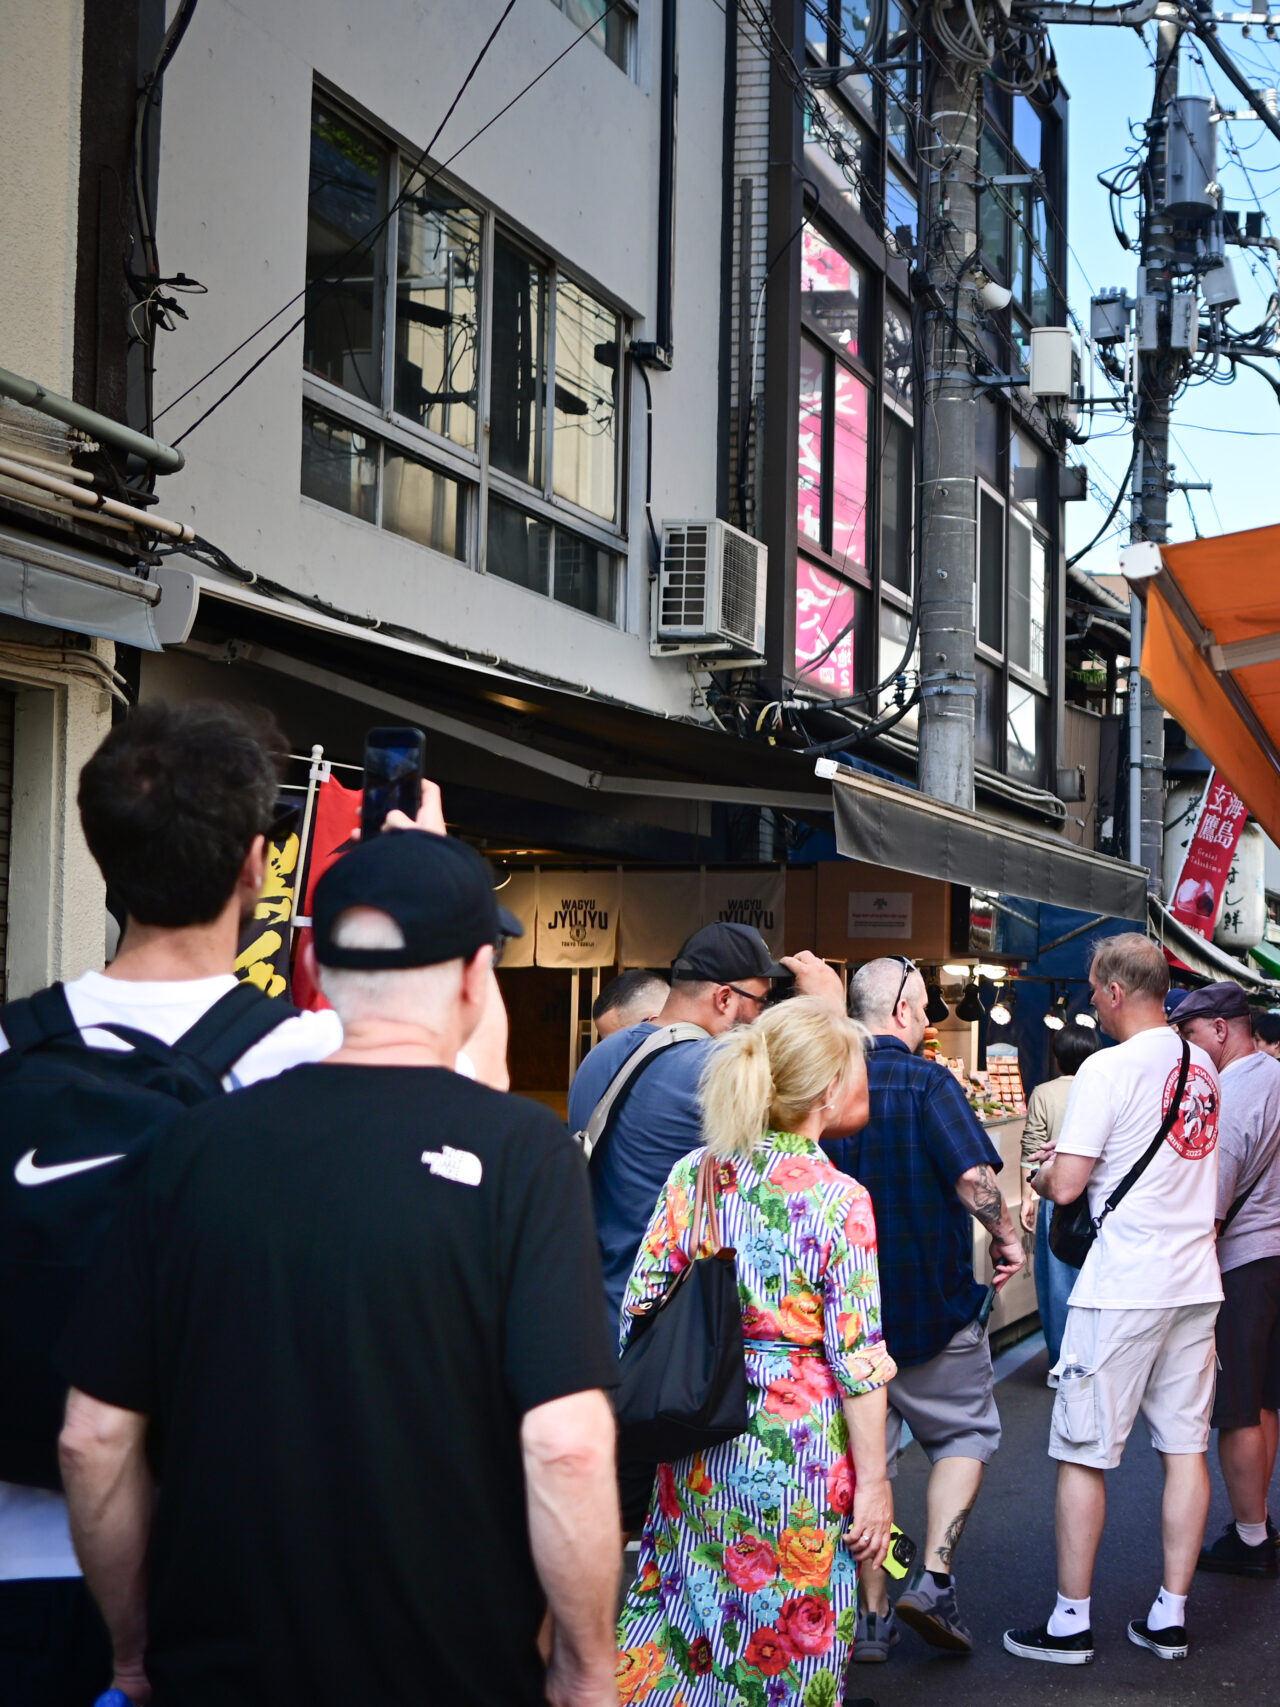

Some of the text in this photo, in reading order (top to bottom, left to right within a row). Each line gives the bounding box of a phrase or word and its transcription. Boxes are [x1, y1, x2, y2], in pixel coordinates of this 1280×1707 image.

[1197, 813, 1235, 849] 鷹島
[561, 899, 596, 911] WAGYU
[727, 899, 761, 910] WAGYU
[548, 910, 608, 929] JYUJYU
